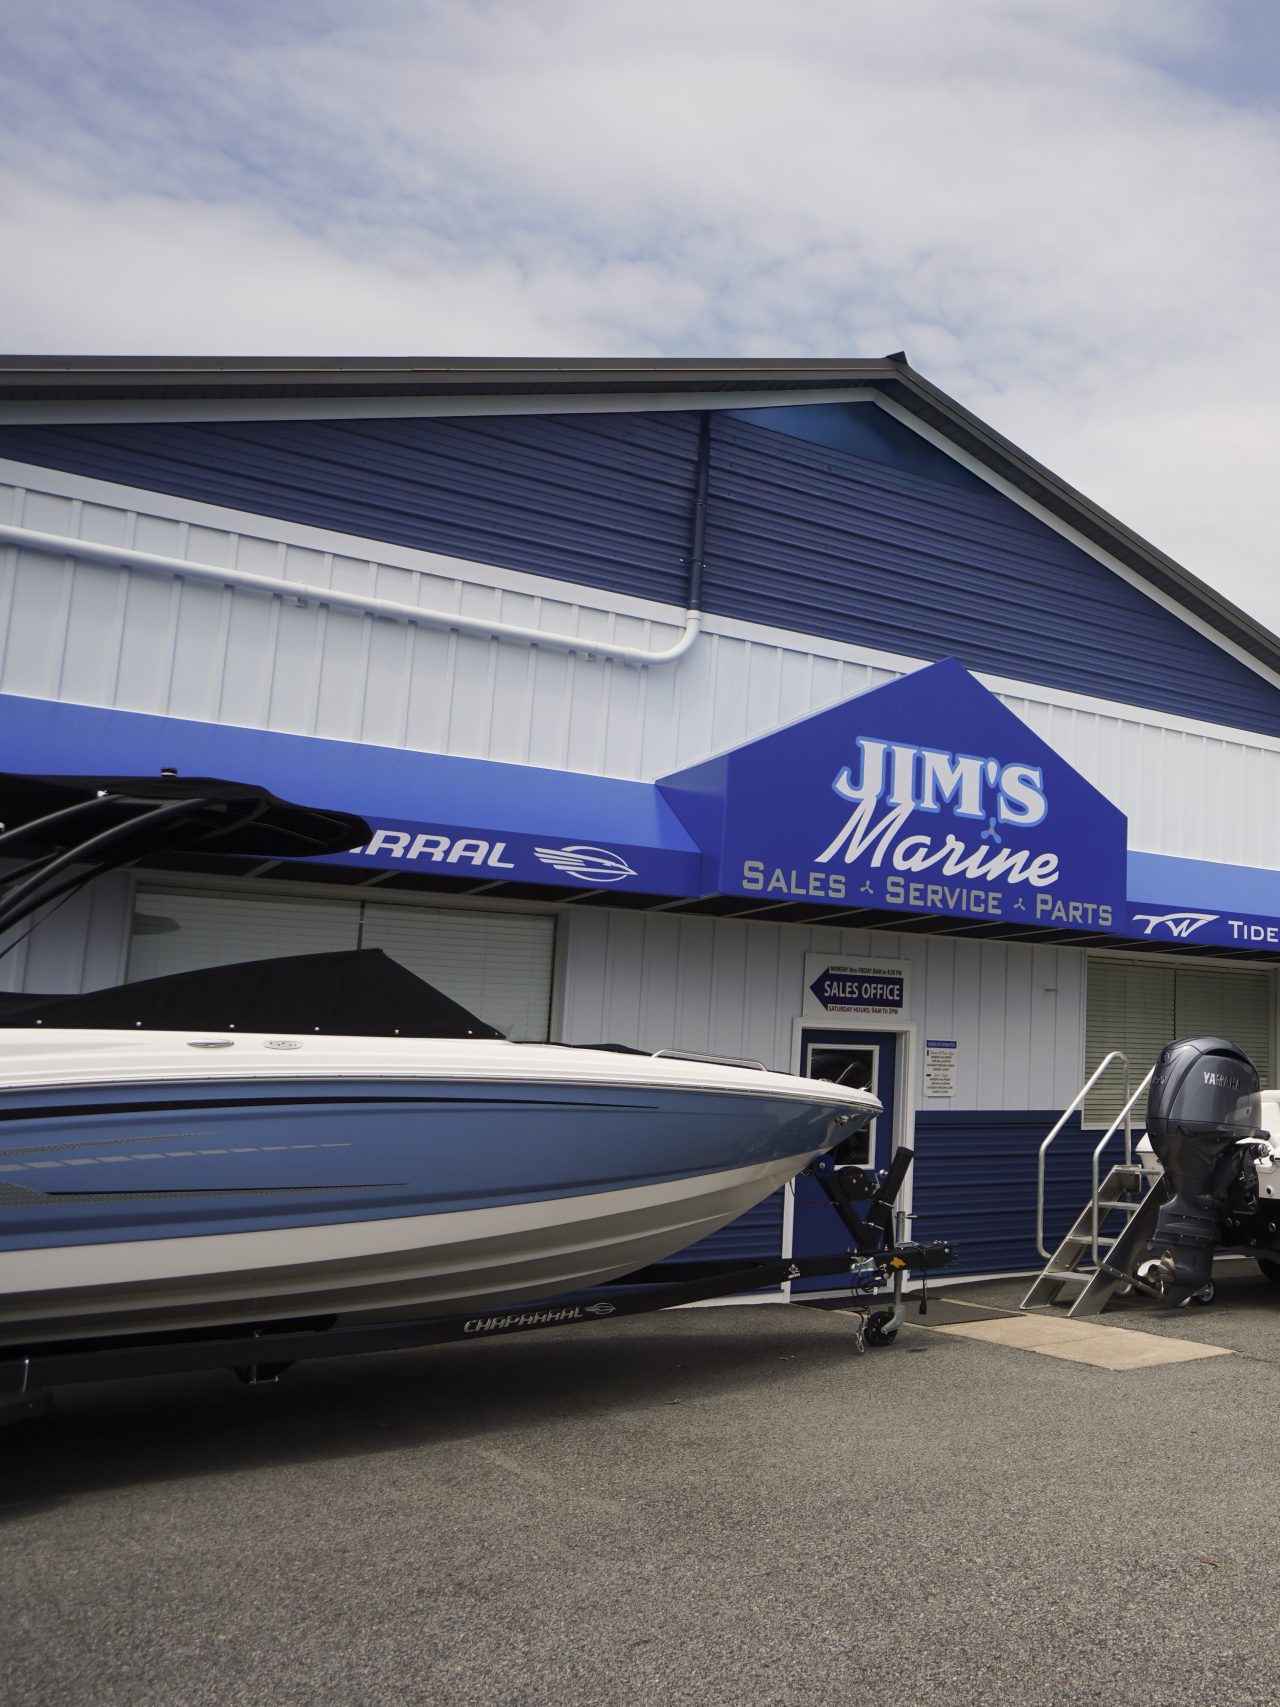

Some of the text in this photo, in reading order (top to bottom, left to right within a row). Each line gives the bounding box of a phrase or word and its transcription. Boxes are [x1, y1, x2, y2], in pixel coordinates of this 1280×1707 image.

[832, 736, 1048, 827] JIM'S
[349, 829, 516, 869] RRAL
[814, 797, 1060, 887] Marine
[824, 980, 901, 1001] SALES OFFICE
[463, 1306, 584, 1333] CHAPARRAL
